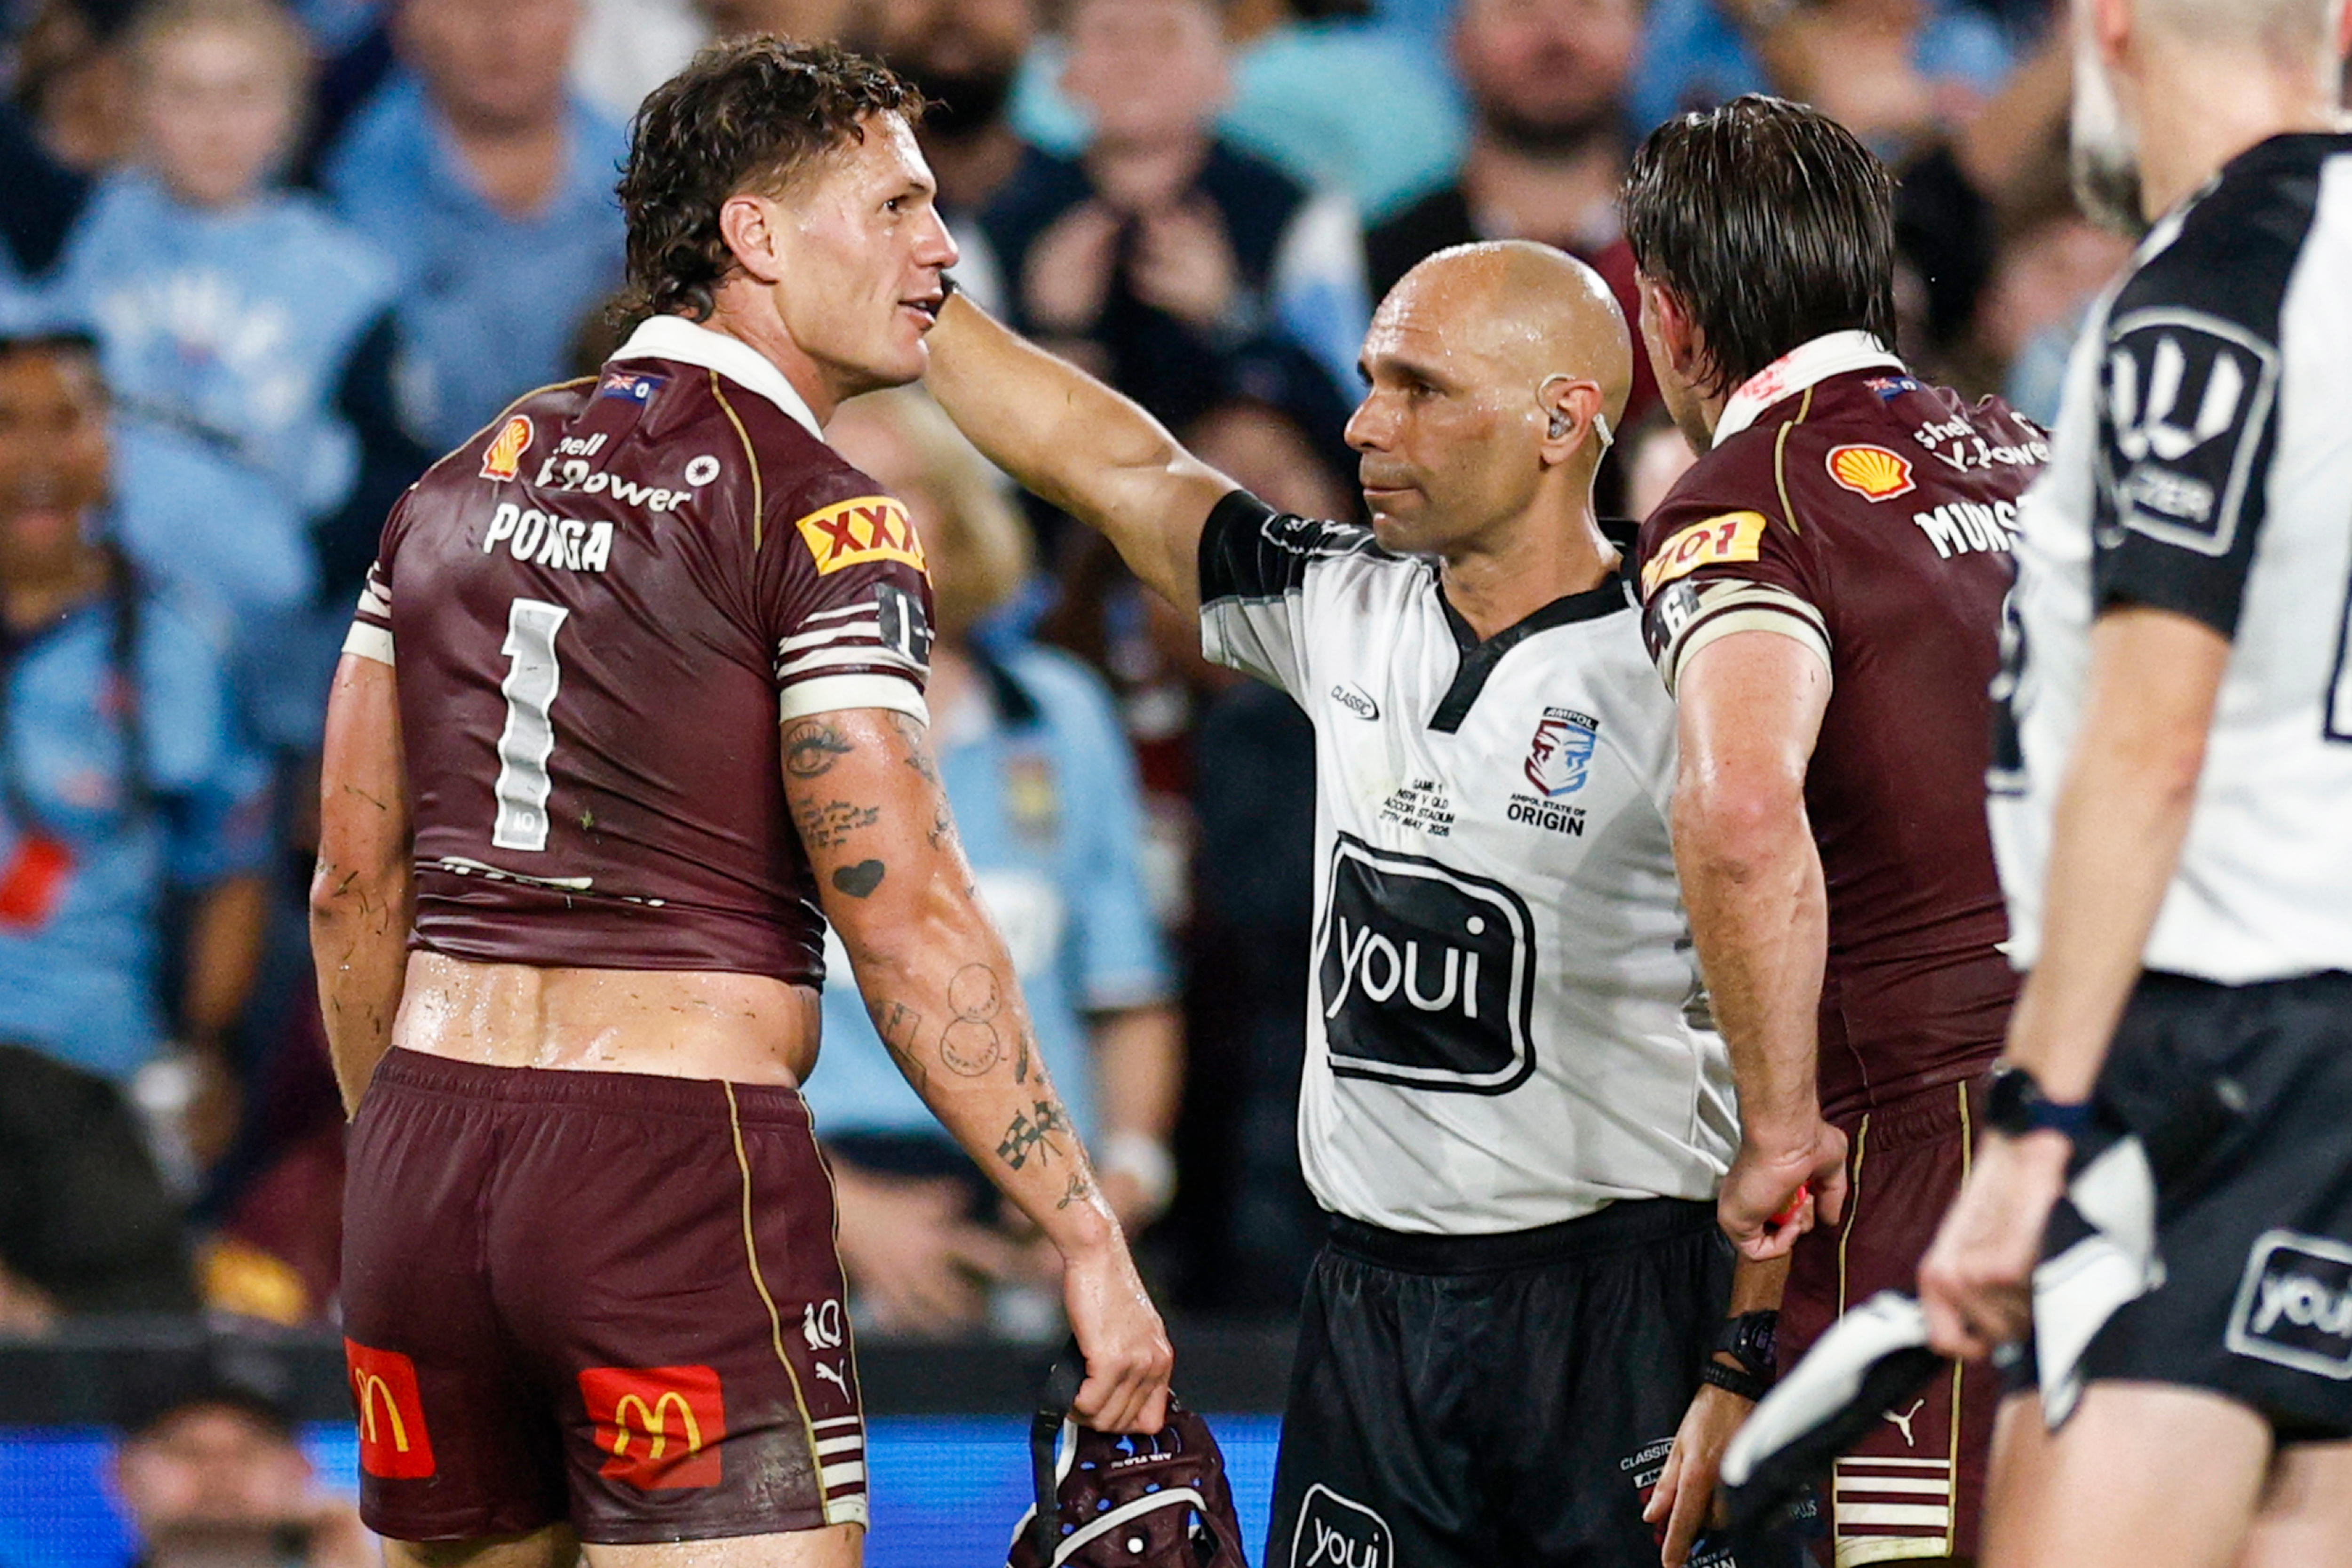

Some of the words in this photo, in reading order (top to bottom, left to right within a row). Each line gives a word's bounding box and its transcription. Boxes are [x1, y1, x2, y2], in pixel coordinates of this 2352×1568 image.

[1932, 438, 2052, 472] V-Powe
[484, 502, 613, 573] PONGA
[493, 598, 569, 851] 1
[1547, 708, 1594, 729] AMPOL
[1384, 797, 1415, 814] ACCOR
[1417, 808, 1455, 824] STADIUM
[1508, 803, 1584, 837] ORIGIN
[1511, 793, 1541, 806] AMPOL
[1543, 801, 1572, 814] STATE
[1574, 808, 1587, 817] OF
[1326, 915, 1486, 1019] youi
[1620, 1442, 1673, 1471] CLASSIC
[1305, 1516, 1380, 1568] youi
